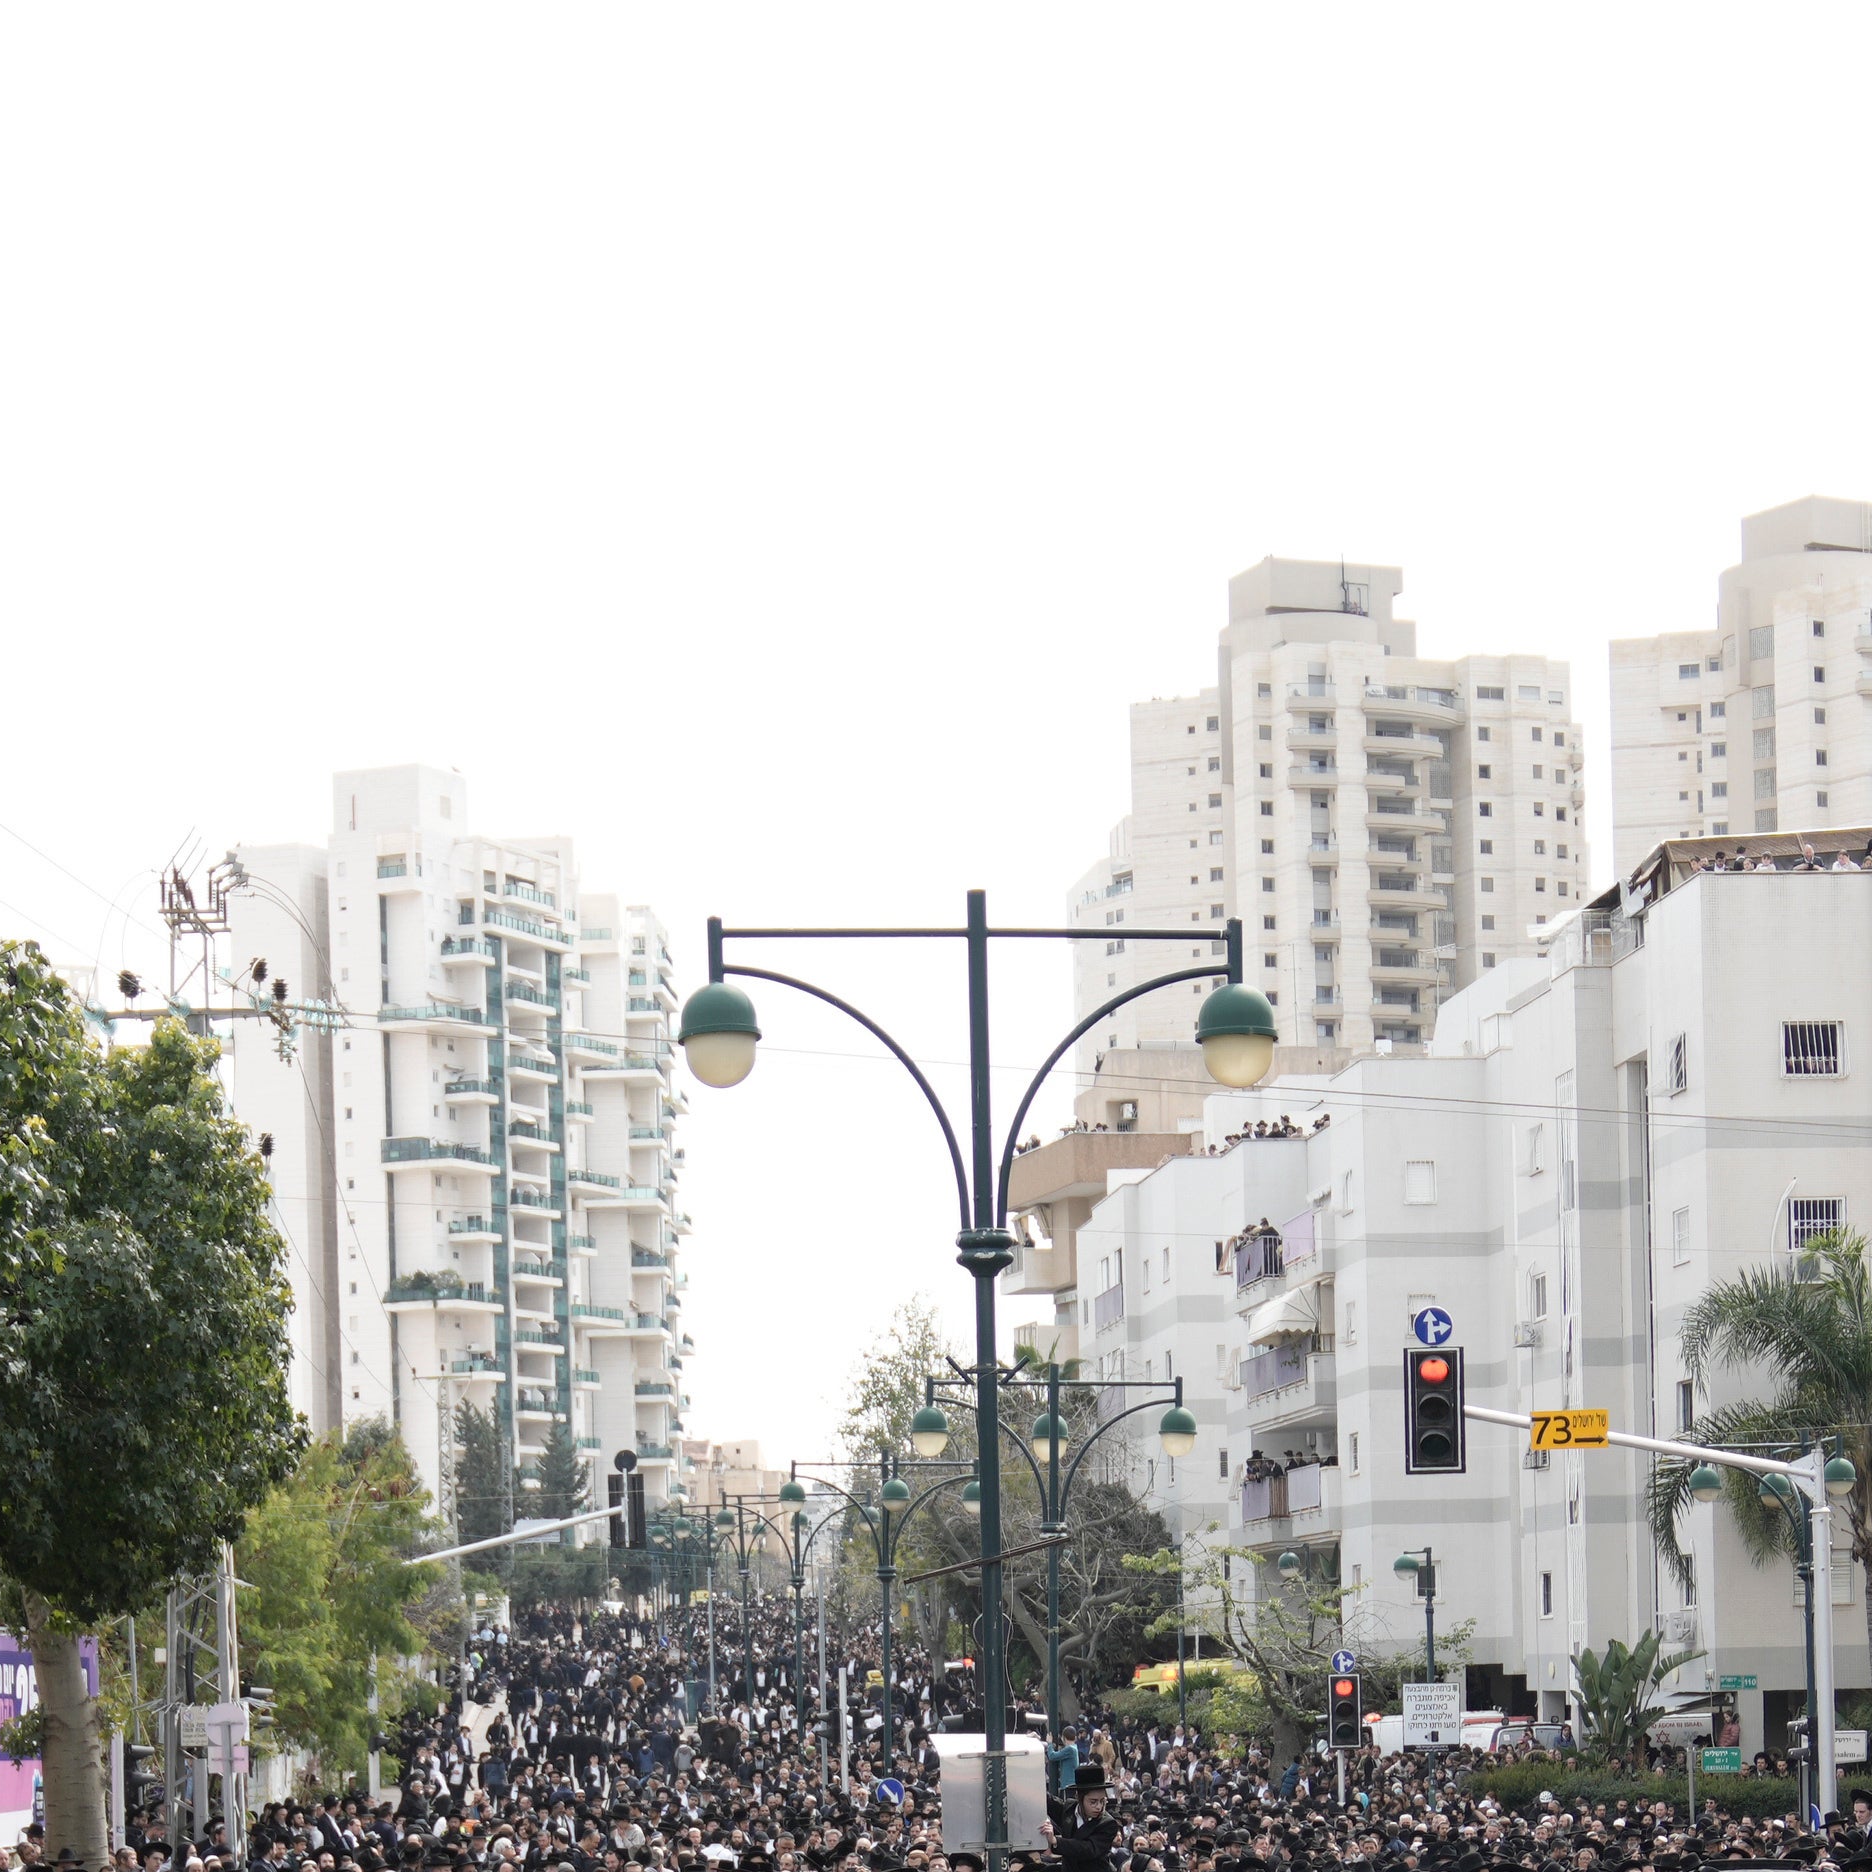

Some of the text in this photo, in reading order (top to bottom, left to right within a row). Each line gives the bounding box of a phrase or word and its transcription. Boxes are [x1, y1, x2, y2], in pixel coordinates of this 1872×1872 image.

[1532, 1416, 1572, 1445] 73
[1573, 1414, 1594, 1428] ירושלים
[3, 1663, 14, 1695] יום
[1744, 1678, 1757, 1686] 110
